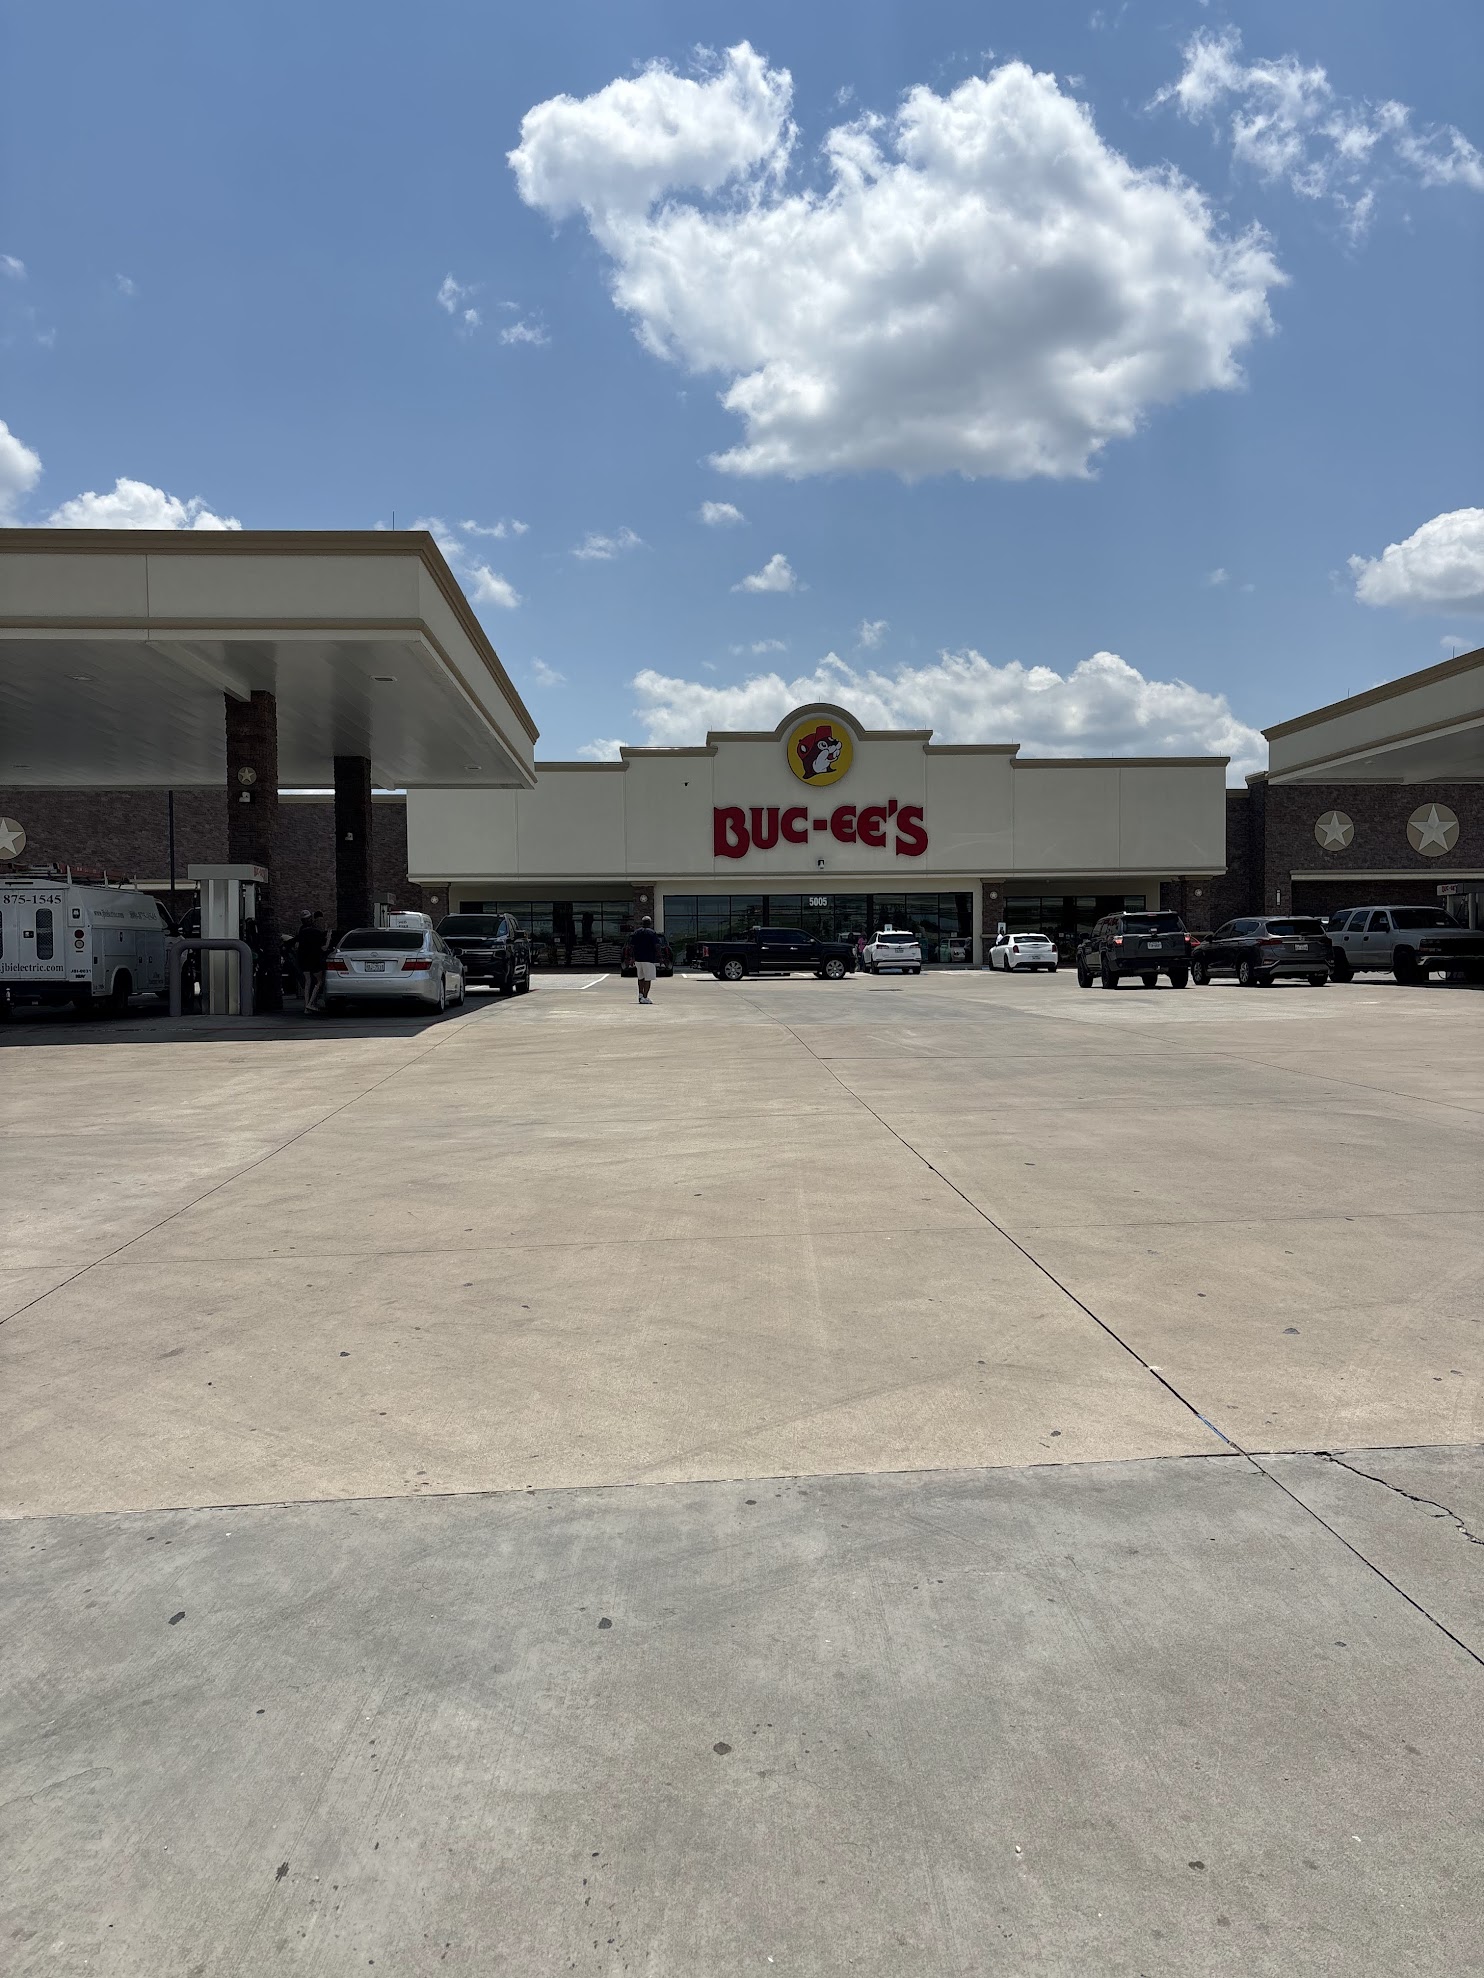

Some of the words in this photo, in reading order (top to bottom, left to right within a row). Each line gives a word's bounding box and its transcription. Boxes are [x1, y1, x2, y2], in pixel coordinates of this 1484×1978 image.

[714, 799, 929, 859] BUC-EE'S
[3, 894, 62, 905] 875-1545
[809, 897, 828, 907] 5005
